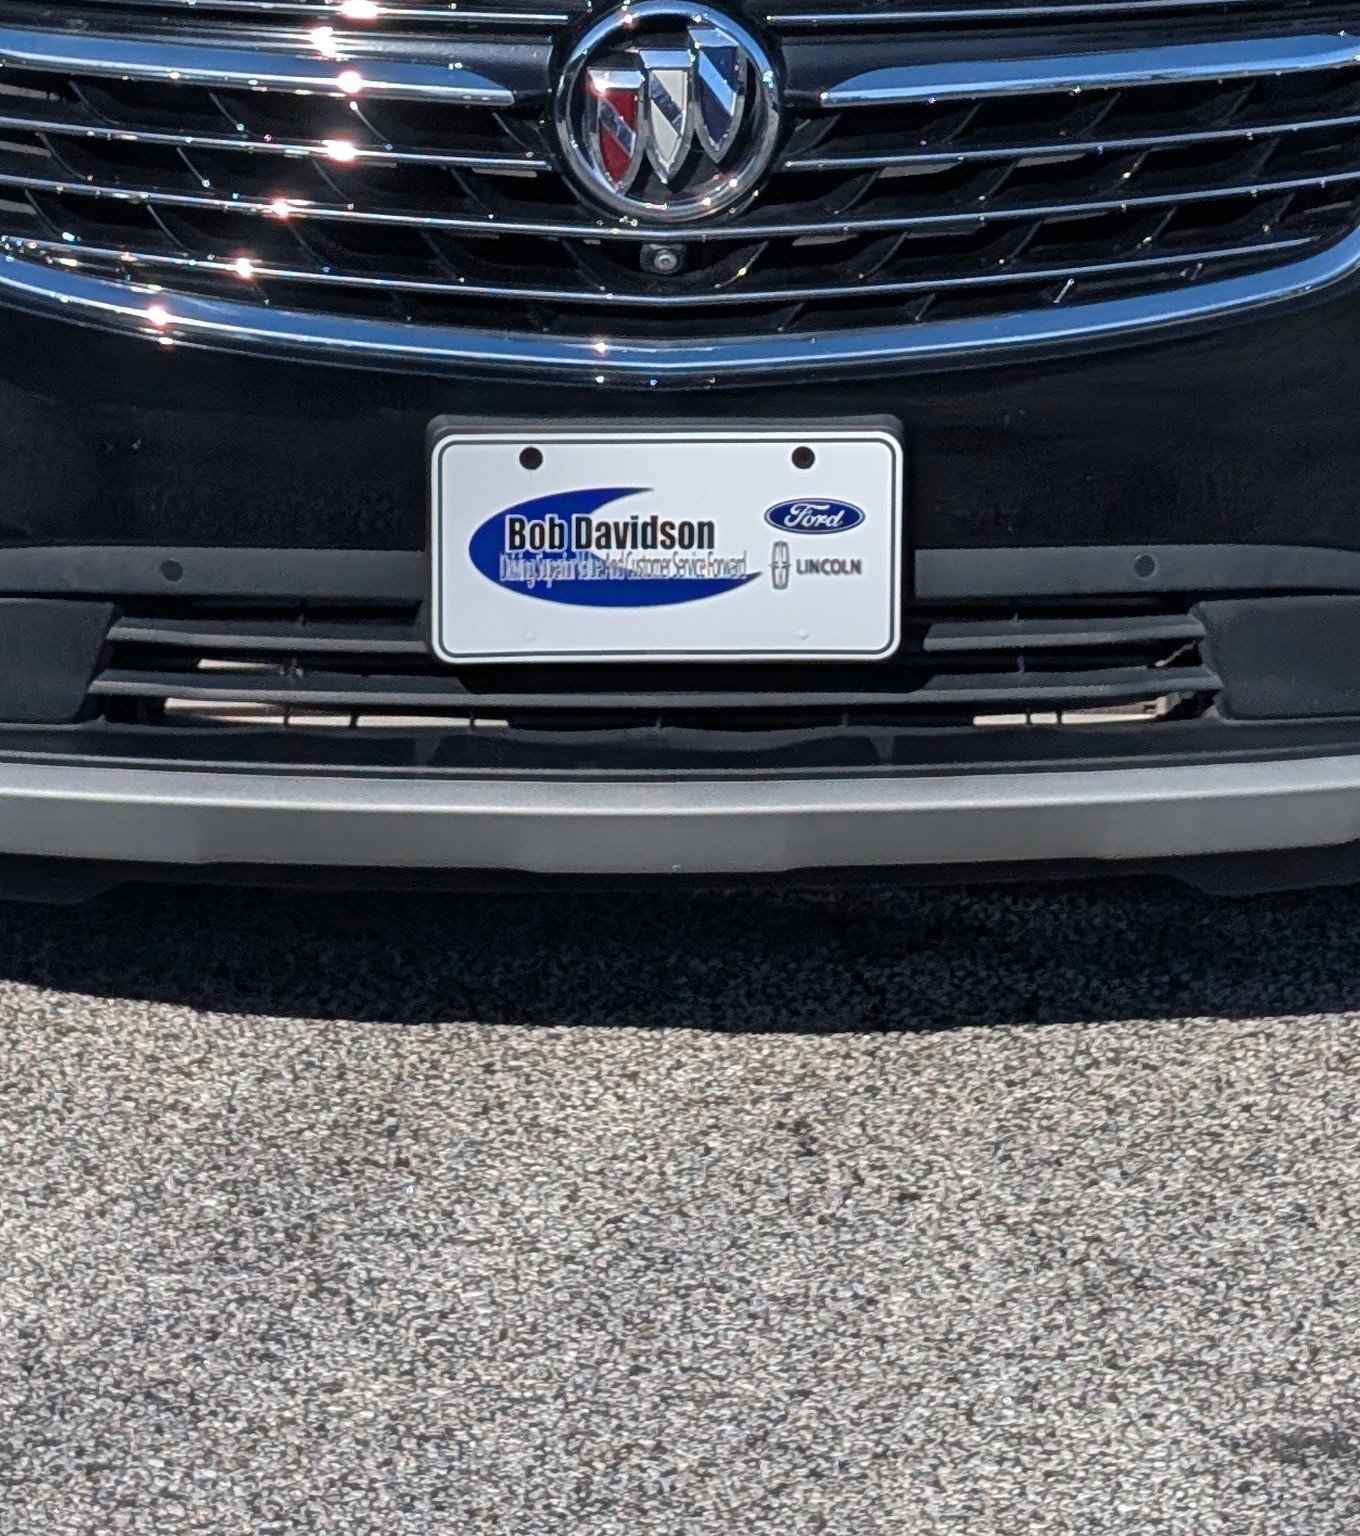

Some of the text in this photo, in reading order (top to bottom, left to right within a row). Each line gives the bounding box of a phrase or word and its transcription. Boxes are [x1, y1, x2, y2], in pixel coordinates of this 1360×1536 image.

[784, 503, 846, 527] Ford
[508, 515, 716, 551] Bob Davidson
[796, 558, 862, 575] LINCOLN
